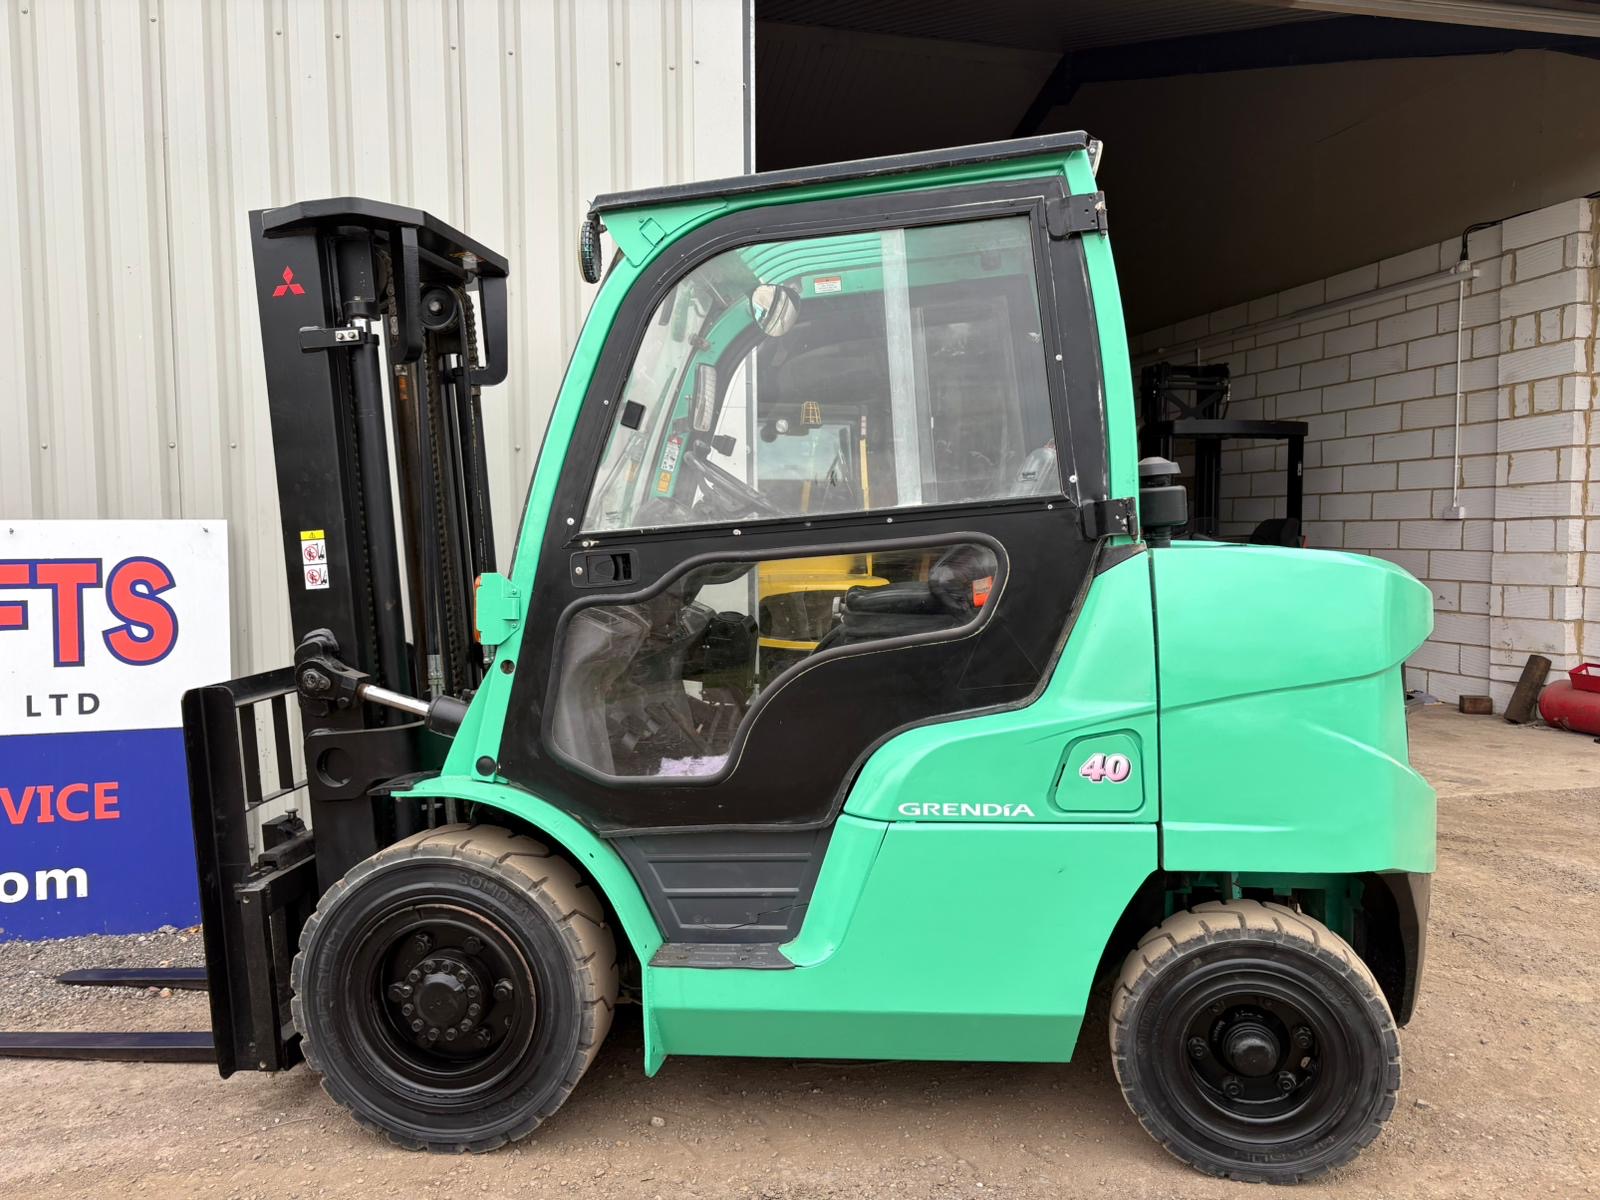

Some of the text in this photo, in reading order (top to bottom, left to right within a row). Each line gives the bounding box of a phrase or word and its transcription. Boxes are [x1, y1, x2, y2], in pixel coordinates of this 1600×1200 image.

[26, 693, 100, 717] LTD
[1079, 753, 1131, 783] 40
[0, 782, 120, 825] VICE
[0, 867, 88, 904] om
